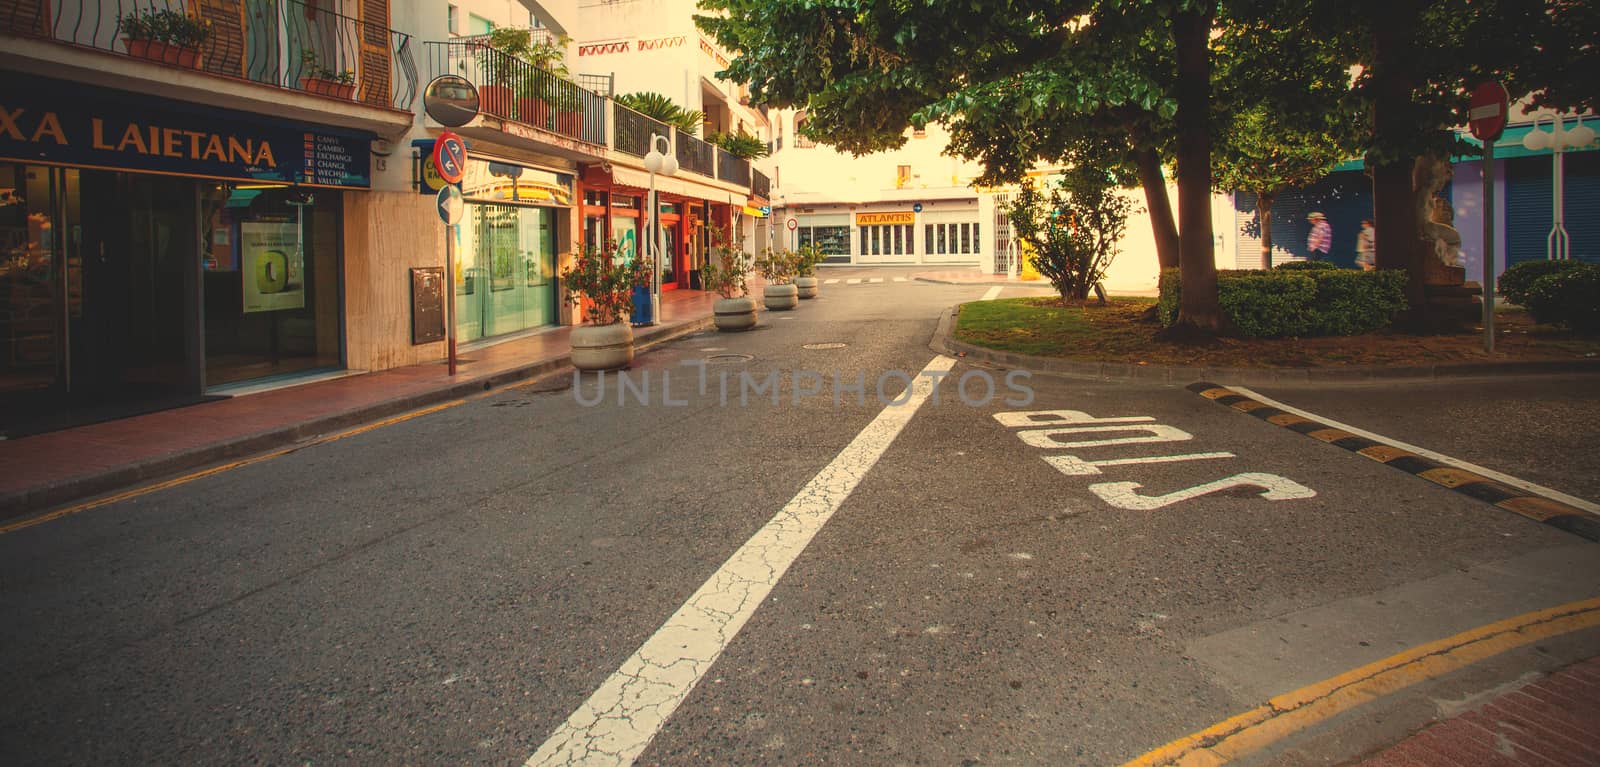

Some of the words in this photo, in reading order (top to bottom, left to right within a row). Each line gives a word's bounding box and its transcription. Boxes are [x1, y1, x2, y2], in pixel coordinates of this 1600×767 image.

[92, 117, 277, 168] LAIETANA
[316, 143, 345, 154] CAMBIO
[316, 152, 352, 162] EXCHANGE
[316, 160, 345, 170] CHANGE
[316, 169, 348, 179] WECHSEL
[316, 177, 343, 185] VALUTA
[860, 213, 912, 222] ATLANTIS
[992, 410, 1317, 511] STOP
